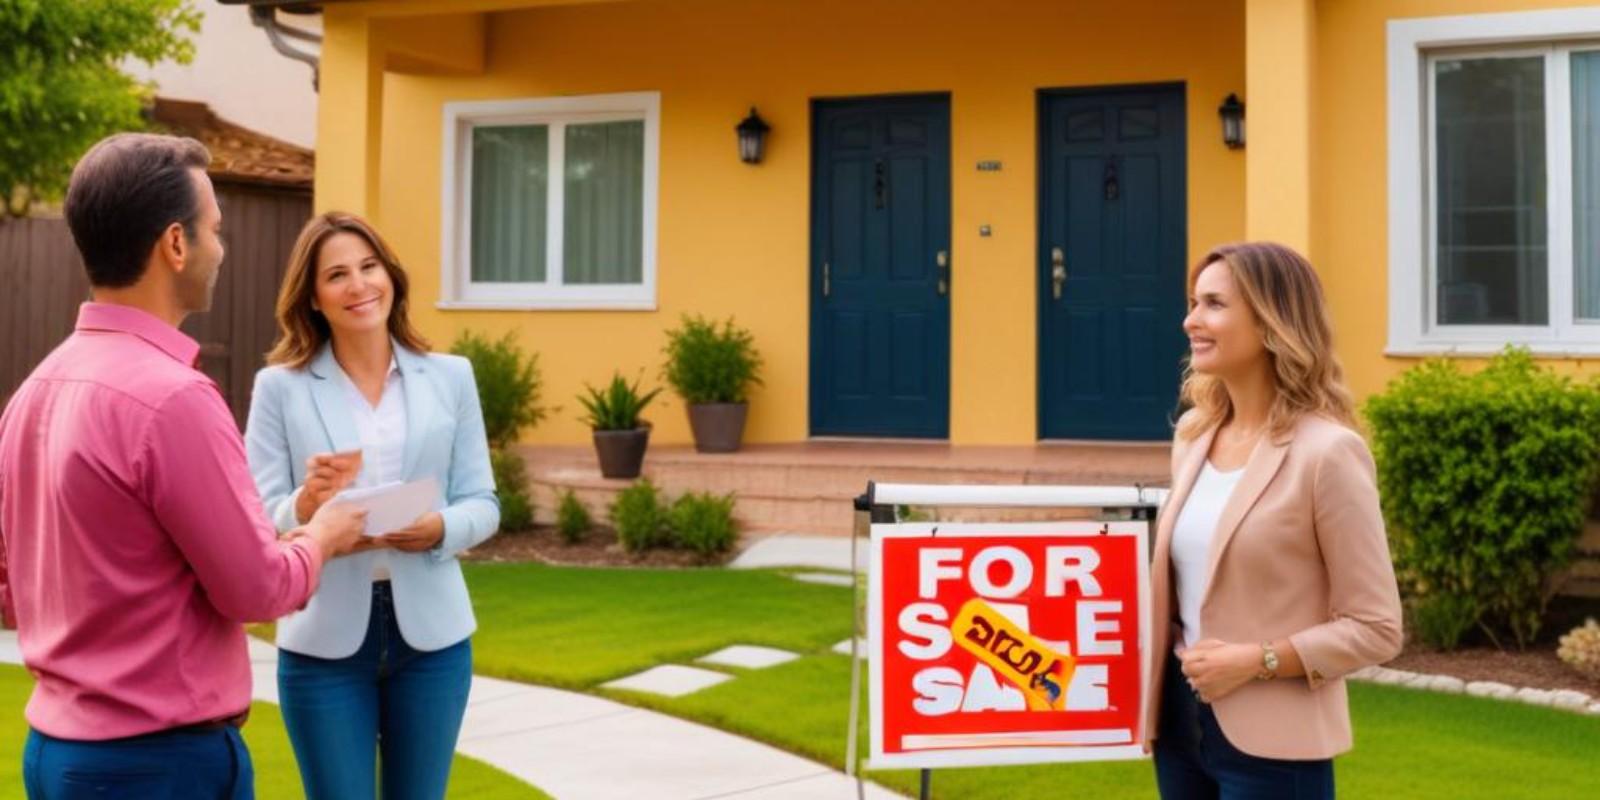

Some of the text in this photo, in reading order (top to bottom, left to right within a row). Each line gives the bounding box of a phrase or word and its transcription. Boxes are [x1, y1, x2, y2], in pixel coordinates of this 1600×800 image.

[918, 545, 1102, 599] FOR
[897, 600, 1124, 660] SLE
[912, 664, 1109, 716] SAE
